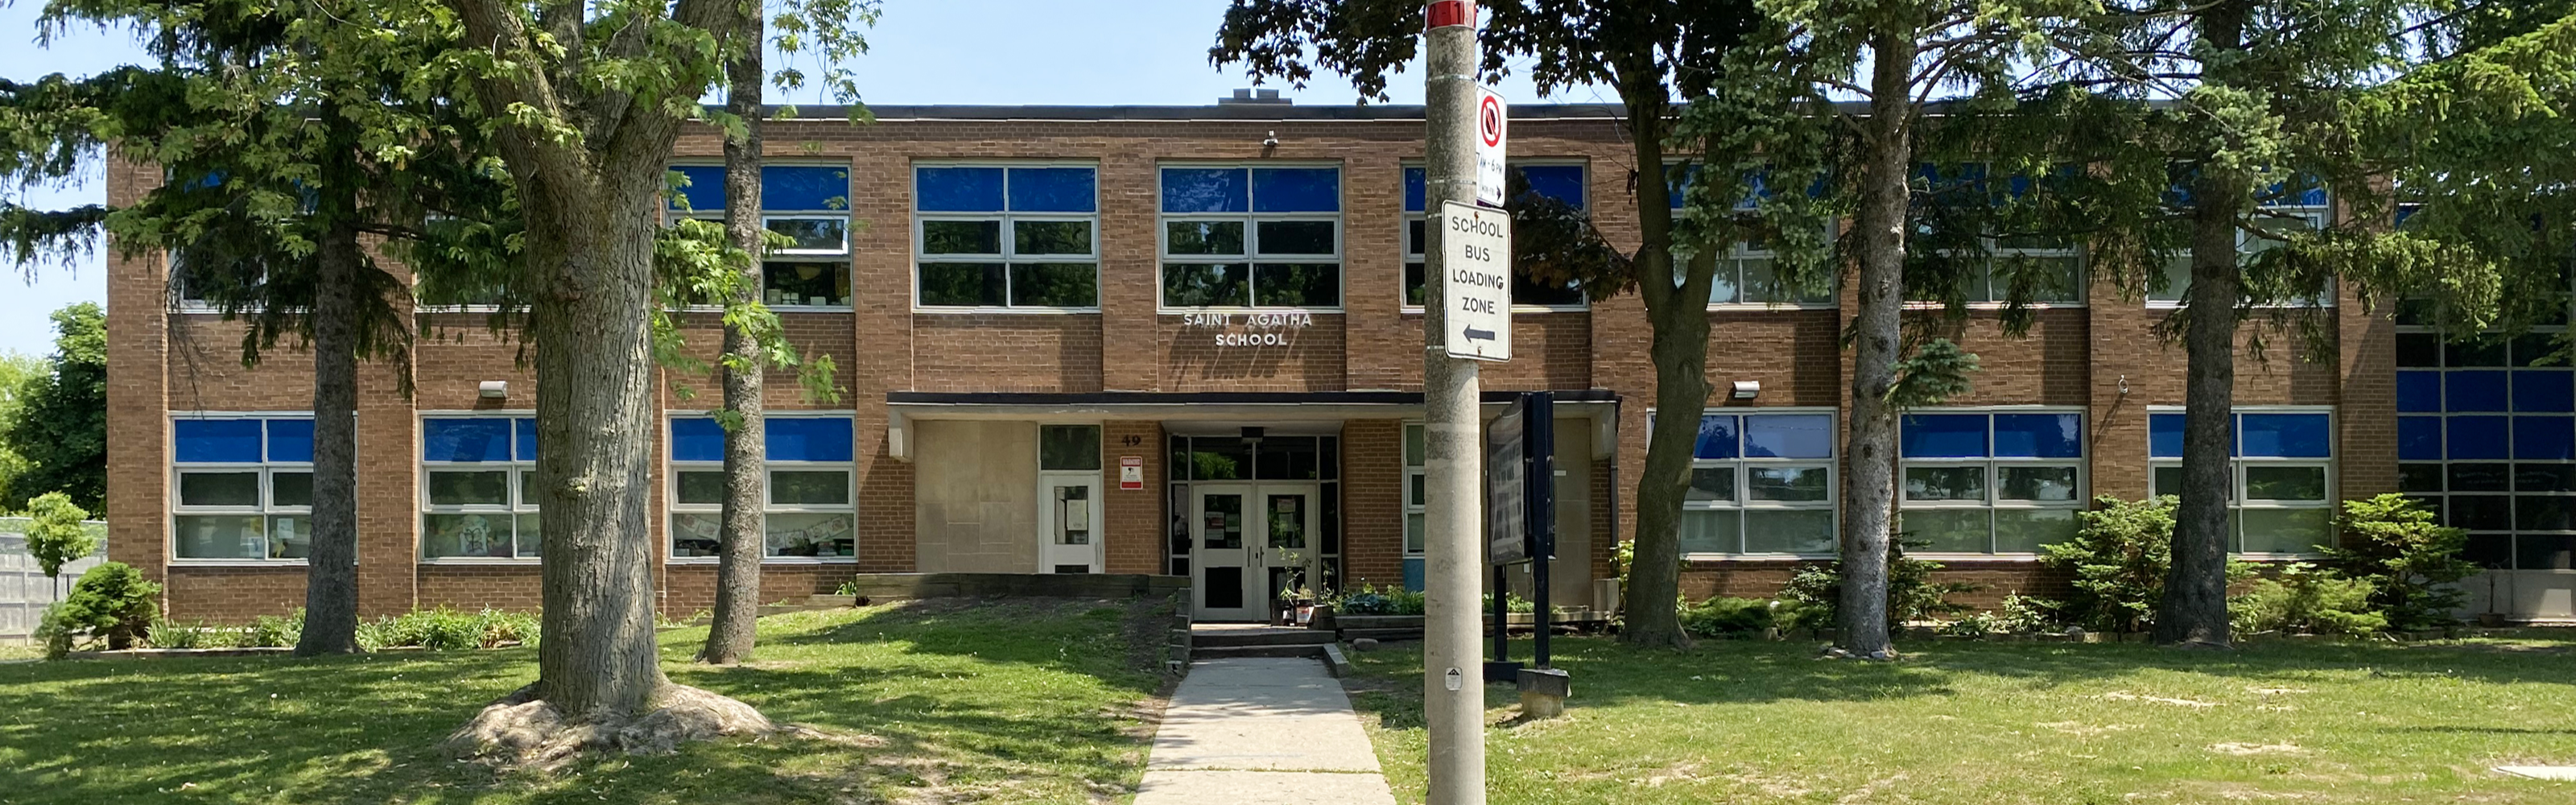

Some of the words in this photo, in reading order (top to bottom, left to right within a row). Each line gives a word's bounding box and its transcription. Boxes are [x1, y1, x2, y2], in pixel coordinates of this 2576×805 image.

[1452, 216, 1503, 237] SCHOOL
[1465, 244, 1490, 262] BUS
[1453, 268, 1504, 290] LOADING
[1462, 296, 1496, 315] ZONE
[1183, 314, 1232, 326] SAINT
[1245, 314, 1312, 326] AGATHA
[1215, 333, 1287, 346] SCHOOL
[1121, 435, 1141, 447] 49
